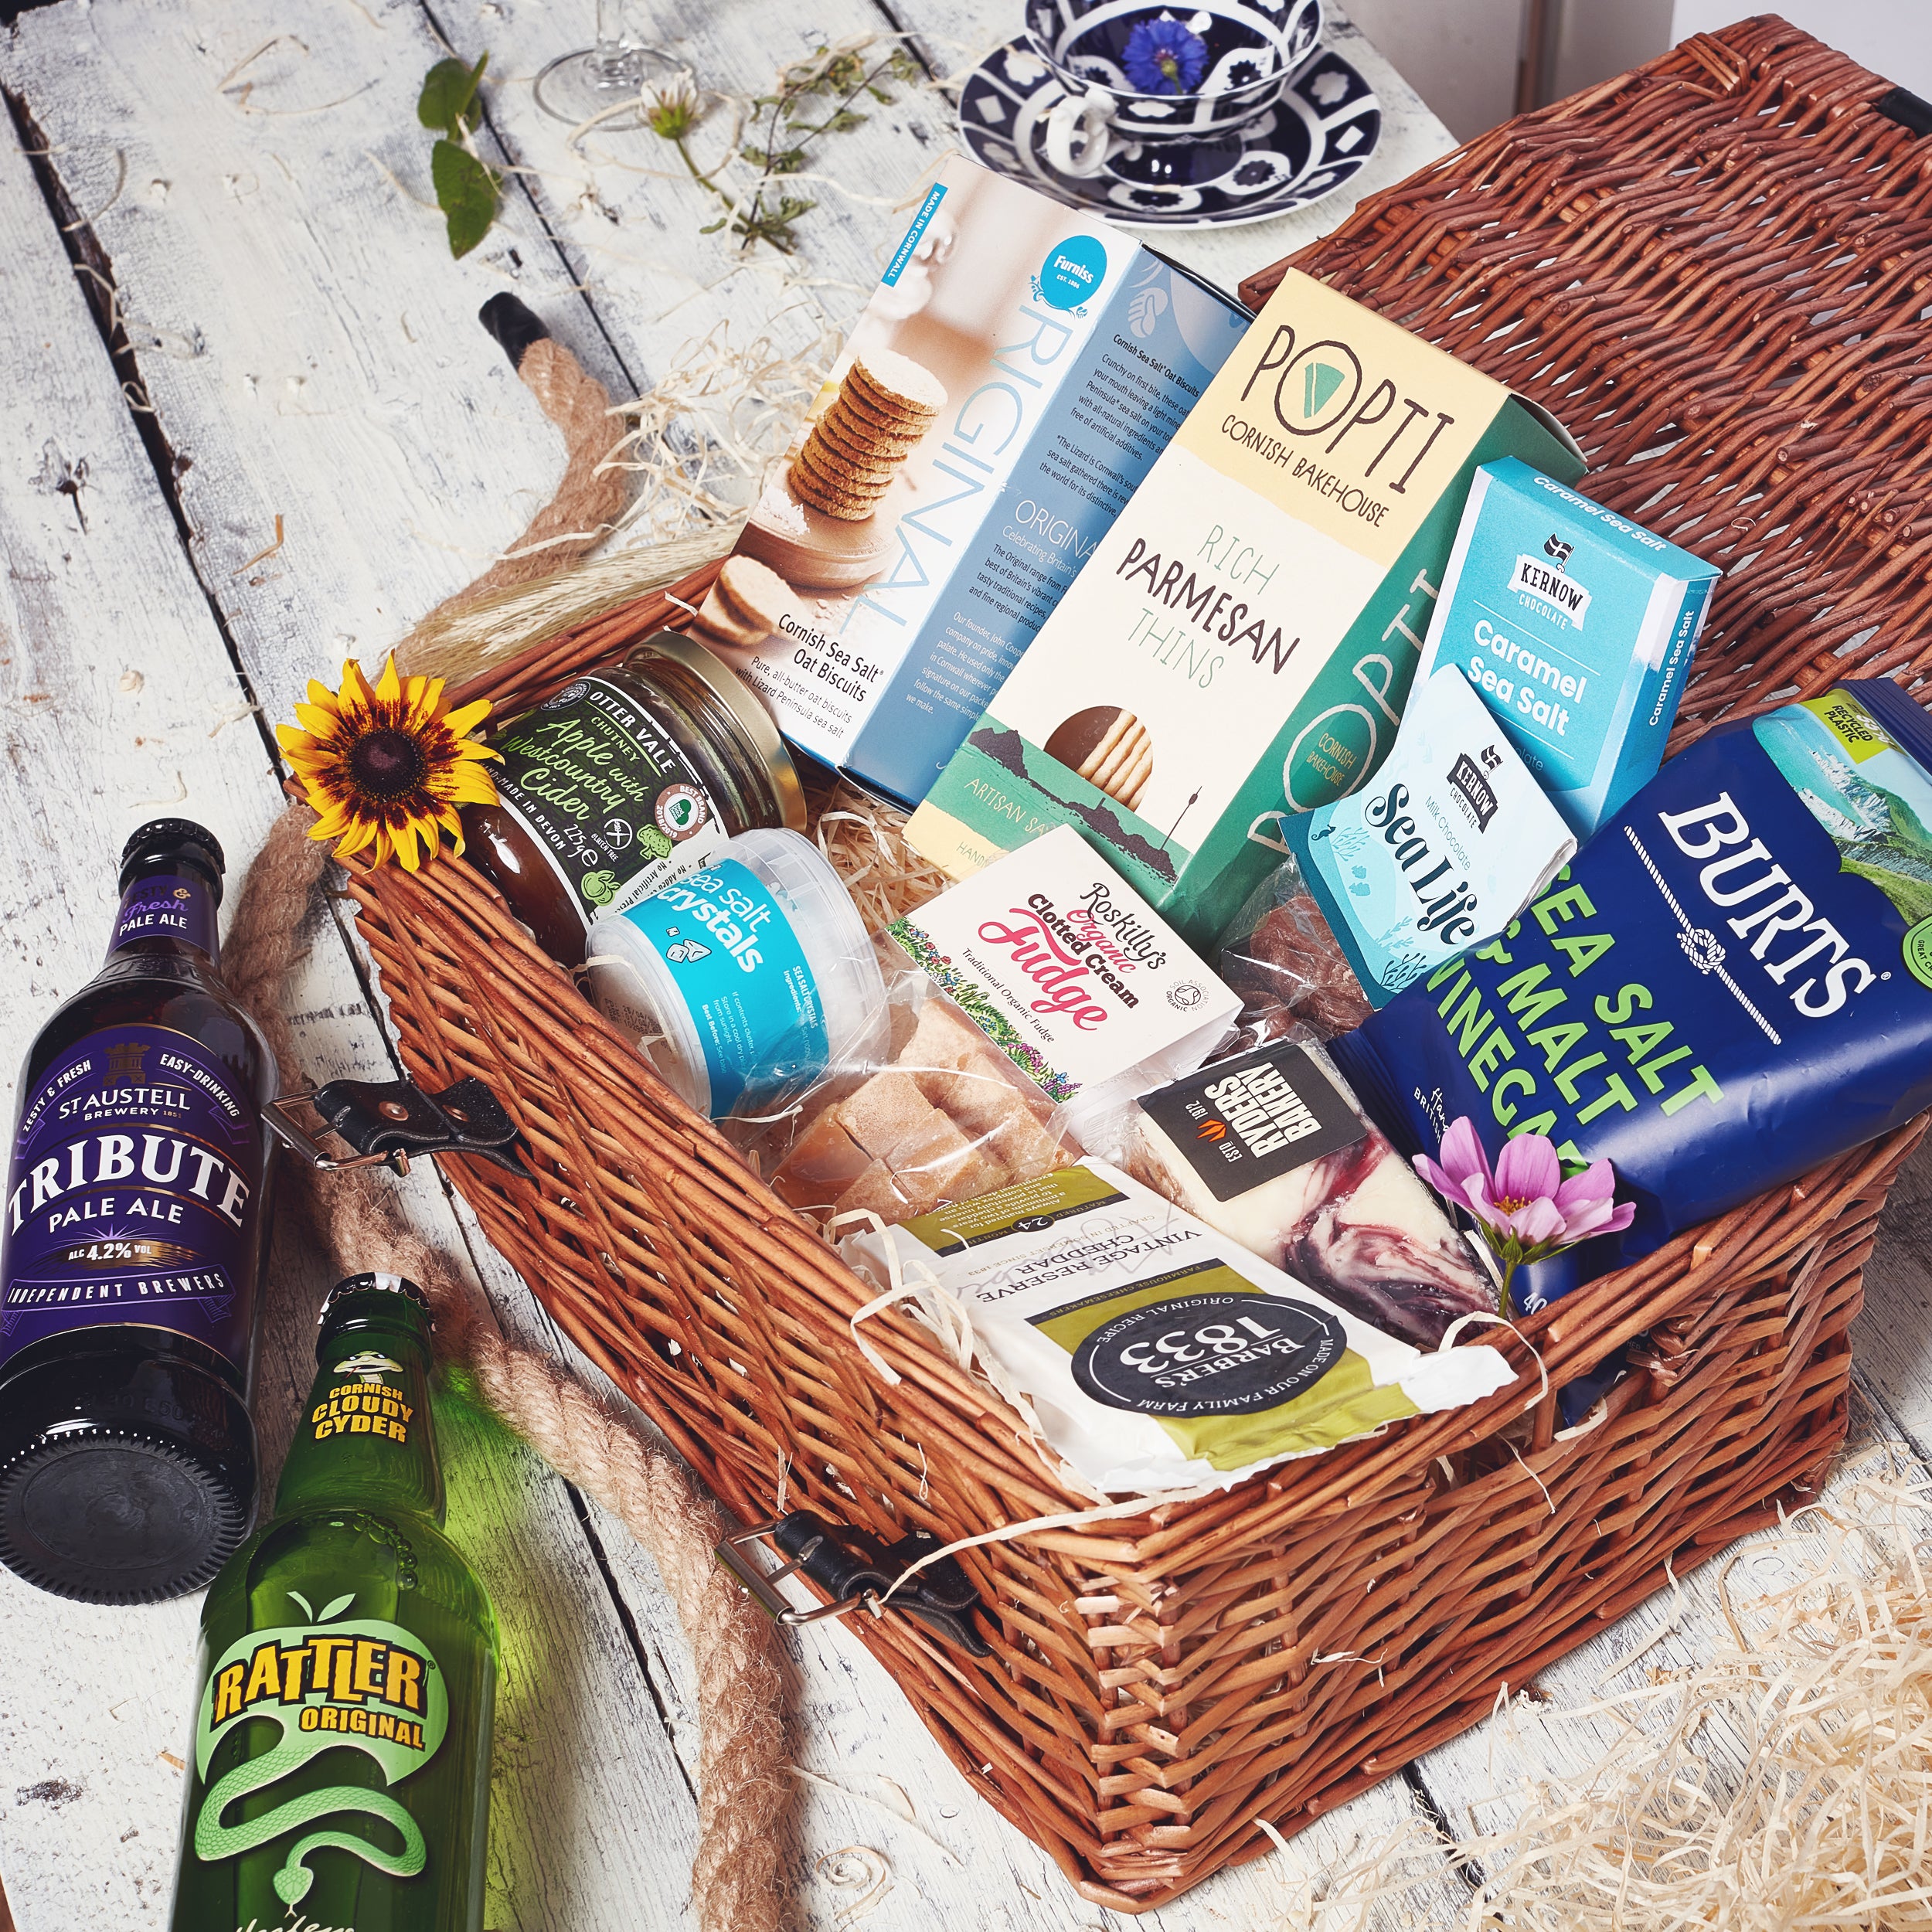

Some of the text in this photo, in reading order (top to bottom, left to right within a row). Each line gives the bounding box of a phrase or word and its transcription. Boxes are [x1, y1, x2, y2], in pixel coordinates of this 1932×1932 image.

[887, 190, 940, 280] MADE IN CORNWALL
[1053, 253, 1097, 284] Furniss
[1100, 352, 1180, 411] Crunchy on first bite, these
[1112, 332, 1138, 355] Cornish
[1136, 349, 1151, 365] Sea
[1163, 367, 1176, 382] Oat
[1175, 375, 1201, 398] Biscuits
[1077, 393, 1155, 451] with all-natural ingredients
[1093, 367, 1168, 422] your mouth leaving a light
[1117, 403, 1130, 415] sea
[1128, 408, 1142, 423] salt
[1140, 418, 1150, 429] on
[1147, 423, 1163, 439] your
[1240, 324, 1454, 495] POPTI
[1070, 406, 1145, 461] free of artificial additives.
[1221, 415, 1389, 528] CORNISH BAKEHOUSE
[1532, 471, 1669, 556] Caramel Sea Salt
[1000, 522, 1049, 563] Celebrating
[1199, 526, 1278, 594] RICH
[1116, 537, 1301, 677] PARMESAN
[1517, 594, 1569, 630] CHOCOLATE
[1519, 562, 1583, 611] KERNOW
[776, 612, 828, 651] Cornish
[825, 640, 854, 667] Sea
[1128, 607, 1226, 689] THINS
[1475, 620, 1590, 703] Caramel
[1648, 607, 1694, 726] Caramel Sea Salt
[733, 664, 845, 738] with Lizard Peninsula sea salt
[750, 655, 853, 724] Pure, all-butter oat biscuits
[792, 647, 869, 702] Oat Biscuits
[1464, 658, 1570, 736] Sea Salt
[590, 689, 635, 728] OTTER
[635, 727, 677, 774] VALE
[590, 716, 640, 763] CHUTNEY
[1315, 732, 1359, 769] CORNISH
[1824, 709, 1858, 746] PLASTIC
[1833, 705, 1873, 744] RECYCLED
[504, 736, 627, 814] Westcountry
[537, 719, 646, 803] Apple with
[1303, 750, 1347, 786] BAKEHOUSE
[1454, 759, 1495, 818] KERNOW
[521, 769, 589, 821] Cider
[655, 805, 678, 838] 2018/2019
[678, 784, 706, 825] BEST BRAND
[961, 774, 1029, 825] ARTISAN
[1447, 787, 1480, 828] CHOCOLATE
[521, 798, 566, 849] IN DEVON
[589, 832, 619, 862] GLUTEN FREE
[1422, 795, 1478, 871] Milk Chocolate
[629, 861, 667, 899] No Artificial
[1364, 784, 1478, 945] Sea Life
[119, 913, 188, 937] PALE ALE
[122, 899, 189, 923] Fresh
[680, 869, 770, 933] sea salt
[1080, 883, 1166, 970] Roskilly's
[1658, 791, 1872, 1020] BURTS
[657, 888, 764, 973] crystals
[1028, 894, 1140, 1009] Clotted Cream
[1066, 909, 1137, 975] Organic
[1917, 939, 1927, 960] GREAT
[782, 969, 802, 1014] Ingredients:
[960, 947, 1056, 1046] Traditional Organic Fudge
[978, 907, 1108, 1031] Fudge
[1169, 979, 1209, 1011] SOIL ASSOCIATION
[792, 965, 818, 1029] SEA SALT CRYSTALS
[1166, 991, 1188, 1012] ORGANIC
[701, 1004, 721, 1046] Best Before:
[1496, 963, 1638, 1125] MALT
[1594, 983, 1725, 1117] SALT
[22, 1060, 91, 1131] ZESTY & FRESH
[85, 1087, 191, 1110] AUSTELL
[159, 1053, 240, 1117] EASY-DRINKING
[1185, 1100, 1208, 1120] 1972
[1234, 1062, 1322, 1143] BAKERY
[83, 1107, 158, 1121] BREWERY
[1203, 1075, 1290, 1159] RYDERS
[1414, 1087, 1441, 1143] BRITISH
[8, 1134, 250, 1236] TRIBUTE
[49, 1197, 184, 1233] PALE ALE
[1016, 1197, 1105, 1233] MATURED 24
[68, 1242, 151, 1260] ALC 4.2% VOL
[975, 1224, 1200, 1305] VINTAGE RESERVE
[1015, 1230, 1134, 1277] CHEDDAR
[7, 1272, 224, 1304] INDEPENDENT BREWERS
[1048, 1262, 1201, 1318] FARMHOUSE CHEESEMAKERS
[1097, 1297, 1233, 1343] ORIGINAL RECIPE
[1119, 1316, 1281, 1373] 1833
[1138, 1338, 1335, 1413] MADE ON OUR FAMILY FARM
[1156, 1337, 1304, 1388] BARBER'S
[311, 1398, 414, 1423] CLOUDY
[328, 1383, 403, 1401] CORNISH
[313, 1416, 409, 1444] CYDER
[213, 1637, 428, 1722] RATTLER
[299, 1705, 424, 1750] ORIGINAL
